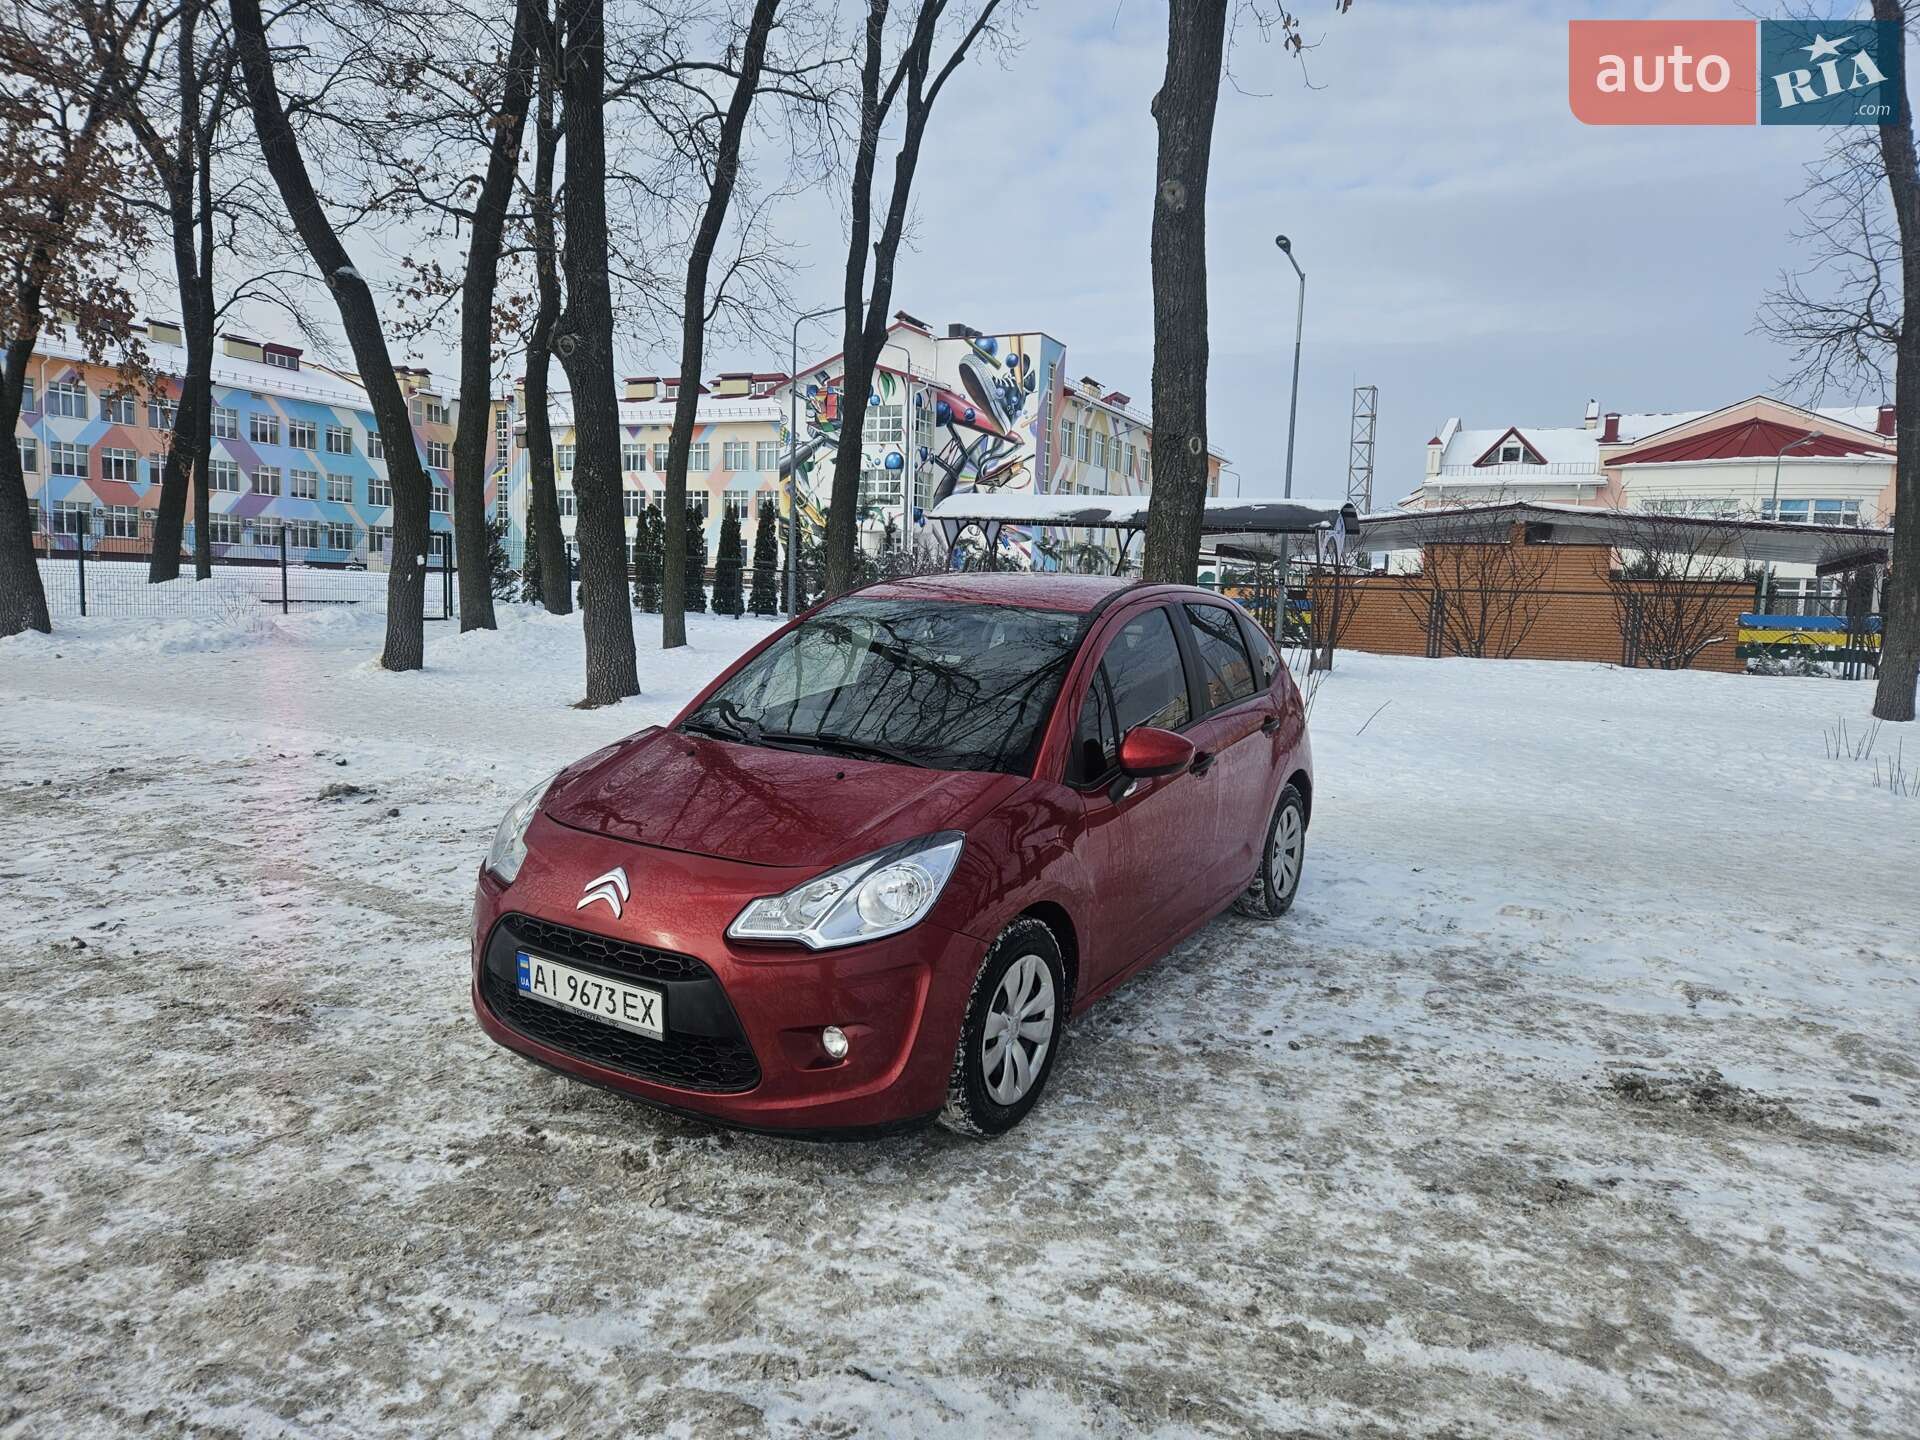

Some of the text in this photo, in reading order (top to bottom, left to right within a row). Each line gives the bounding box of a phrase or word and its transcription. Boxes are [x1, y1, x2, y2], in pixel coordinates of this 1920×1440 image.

[520, 977, 530, 987] UA
[534, 964, 656, 1027] AI 9673 EX
